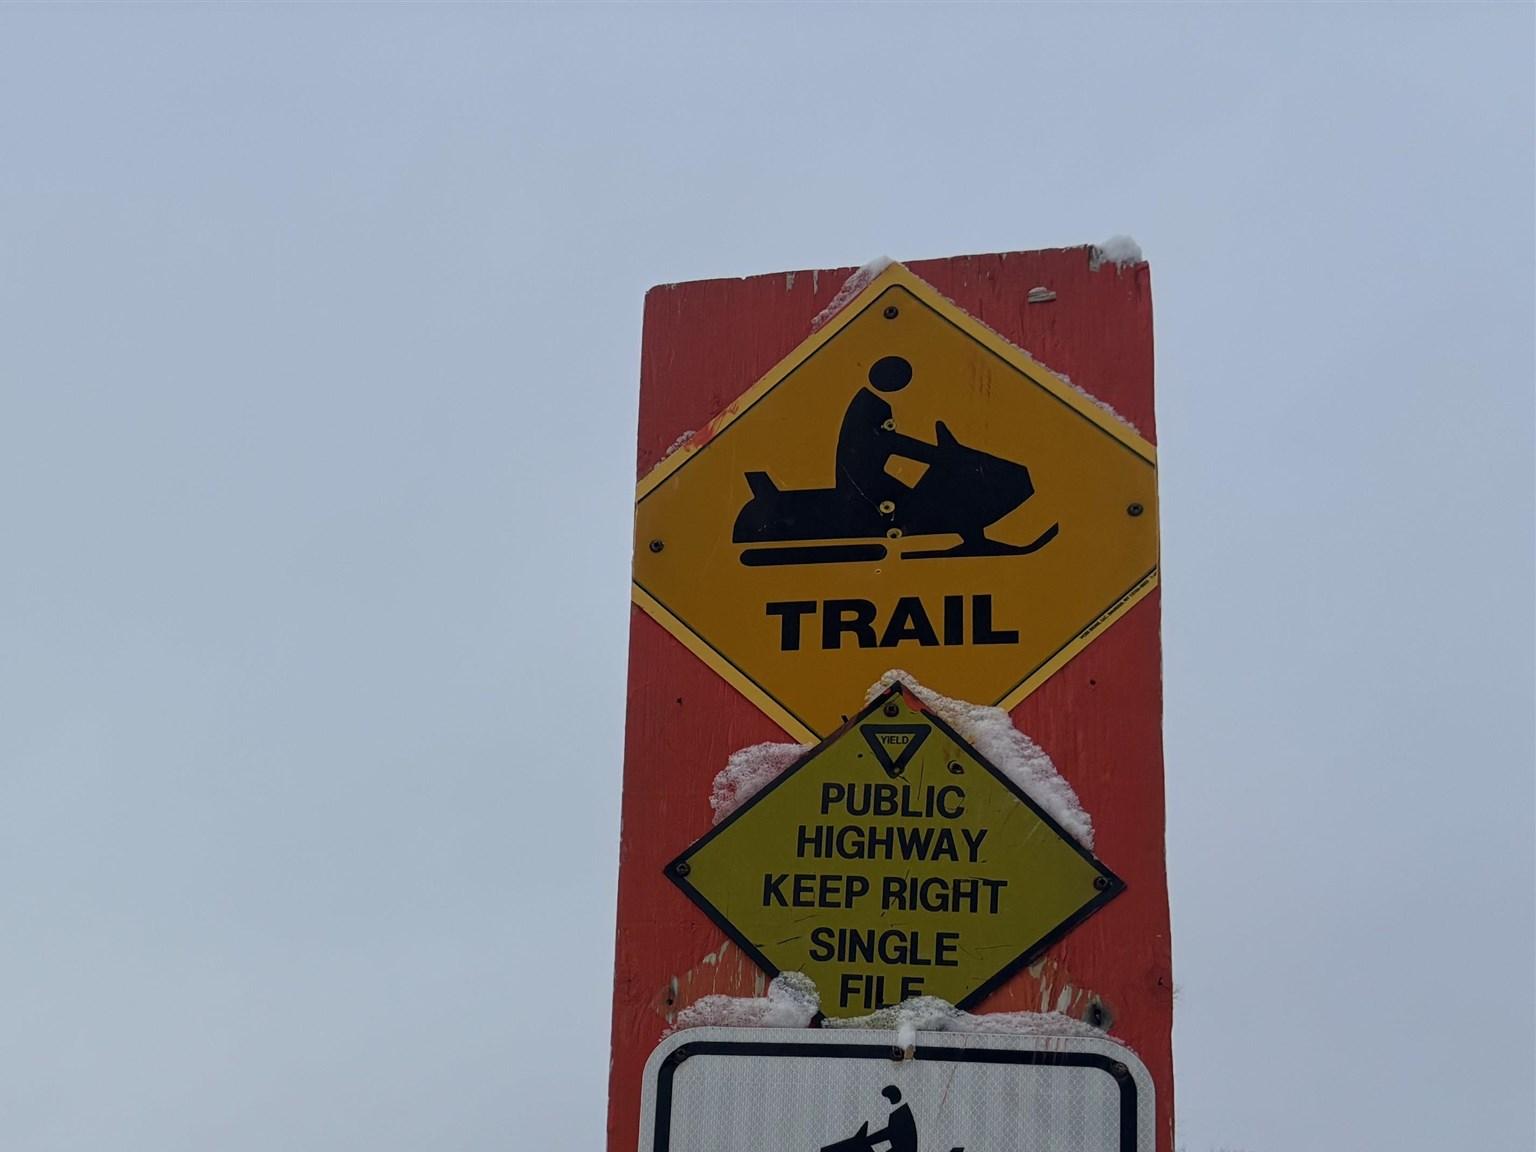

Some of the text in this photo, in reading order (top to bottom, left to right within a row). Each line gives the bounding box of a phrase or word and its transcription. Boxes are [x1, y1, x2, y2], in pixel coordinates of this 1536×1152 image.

[766, 594, 1019, 650] TRAIL
[881, 735, 909, 745] YIELD
[820, 783, 965, 819] PUBLIC
[796, 825, 988, 863] HIGHWAY
[762, 873, 1008, 914] KEEP RIGHT
[808, 927, 960, 966] SINGLE
